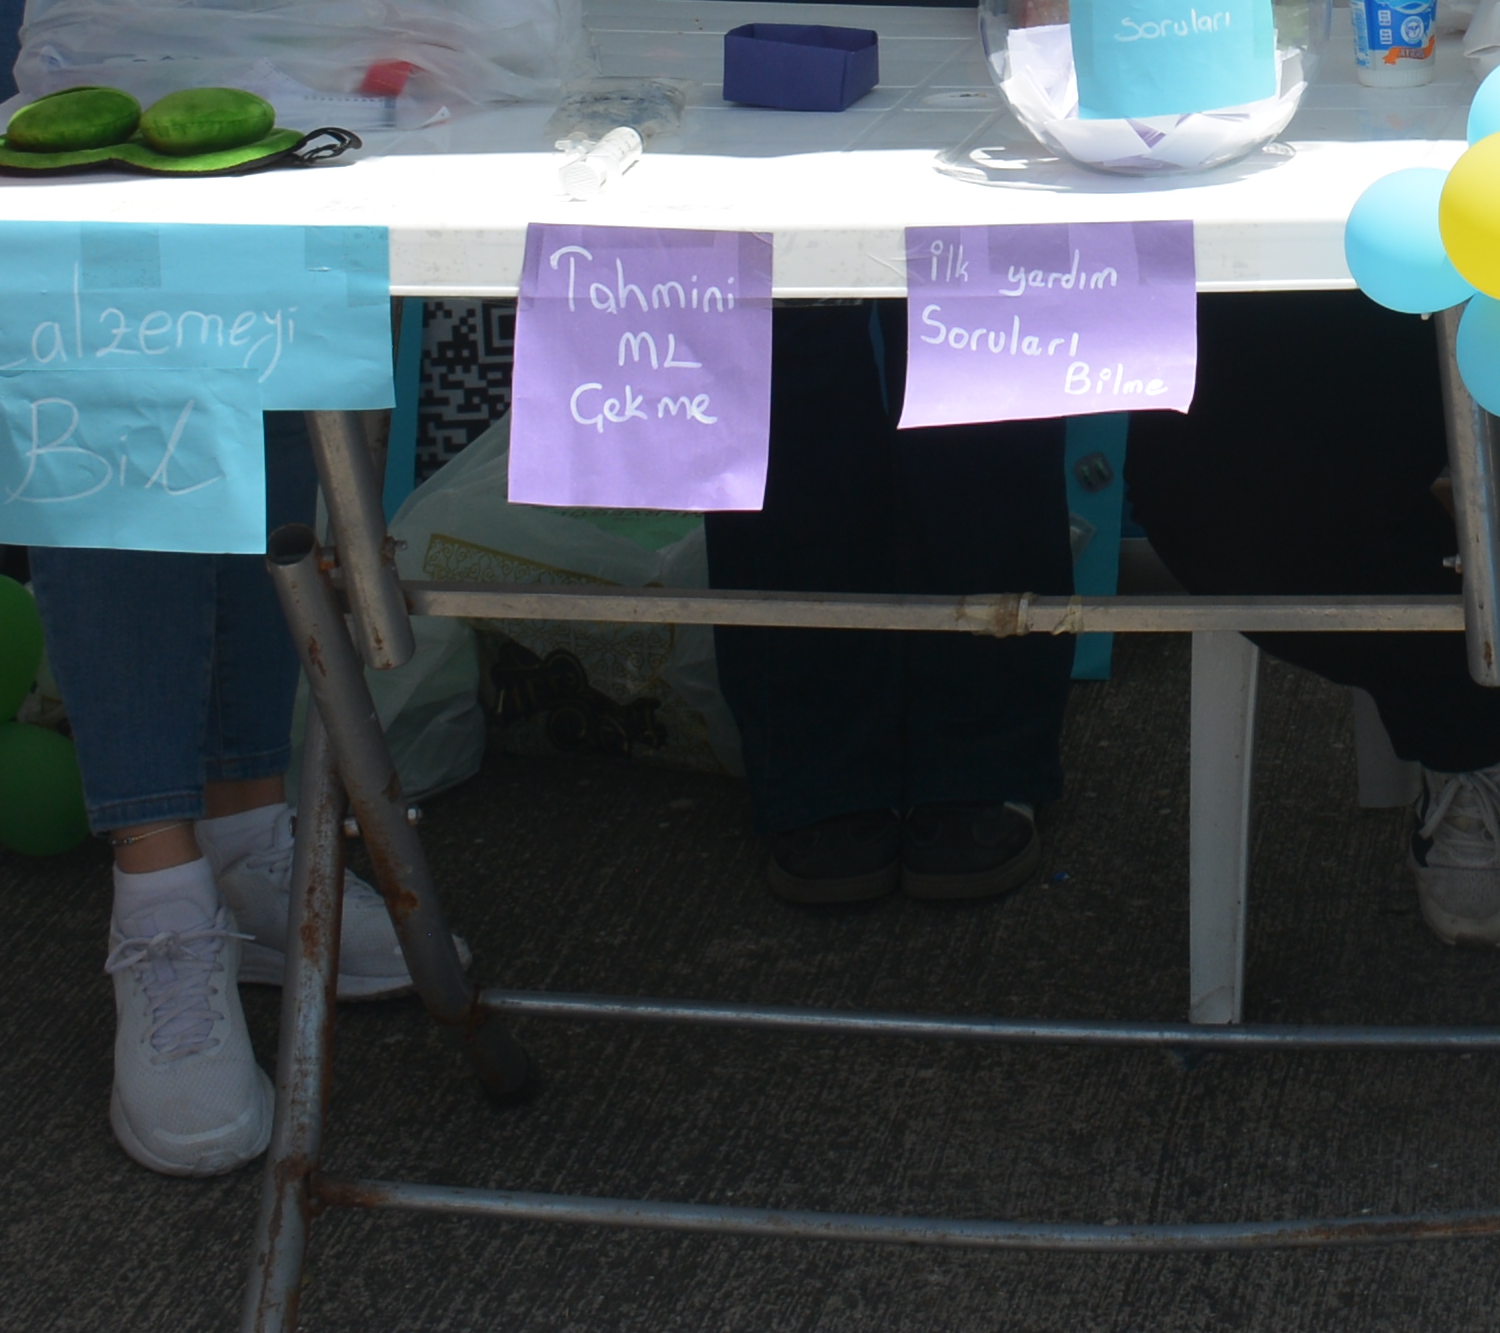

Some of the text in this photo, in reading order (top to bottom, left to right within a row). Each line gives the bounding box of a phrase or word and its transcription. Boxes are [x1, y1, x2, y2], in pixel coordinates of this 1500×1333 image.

[549, 245, 737, 315] Tahmini
[999, 248, 1119, 298] yardım
[617, 330, 703, 369] ML
[919, 303, 1079, 357] Soruları
[1062, 360, 1170, 397] Bilme
[4, 397, 227, 505] Bil
